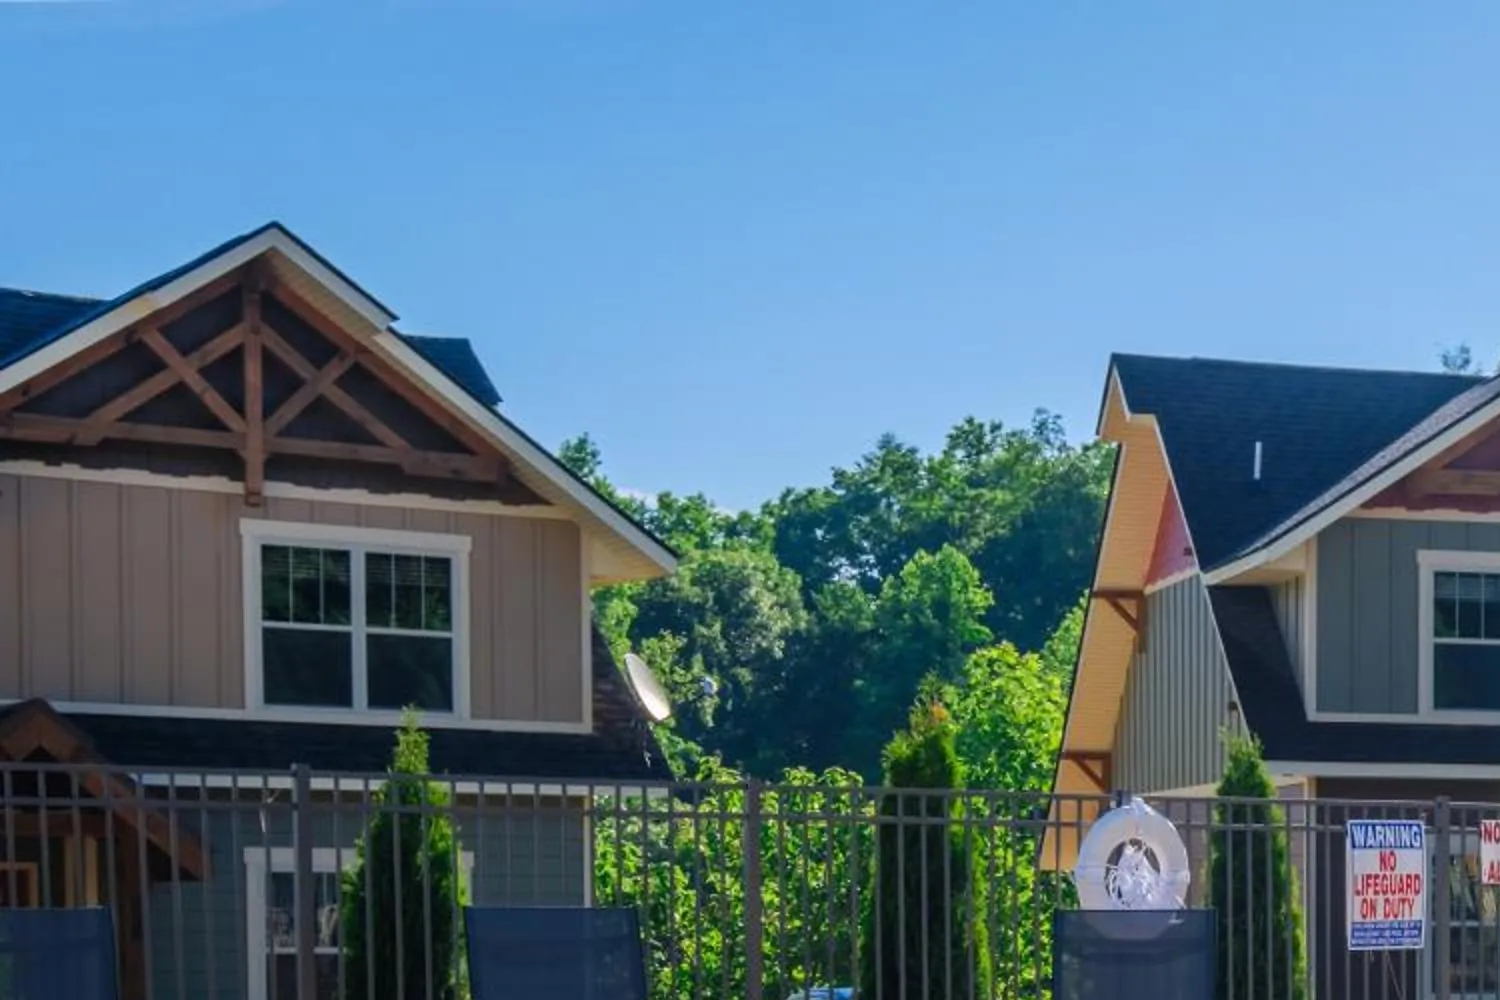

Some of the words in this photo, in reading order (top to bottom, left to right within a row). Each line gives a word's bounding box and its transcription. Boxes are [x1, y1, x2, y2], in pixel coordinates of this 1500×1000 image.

[1352, 824, 1421, 847] WARNING
[1379, 851, 1397, 872] NO
[1355, 874, 1421, 896] LIFEGUARD
[1360, 899, 1379, 920] ON
[1383, 898, 1415, 919] DUTY
